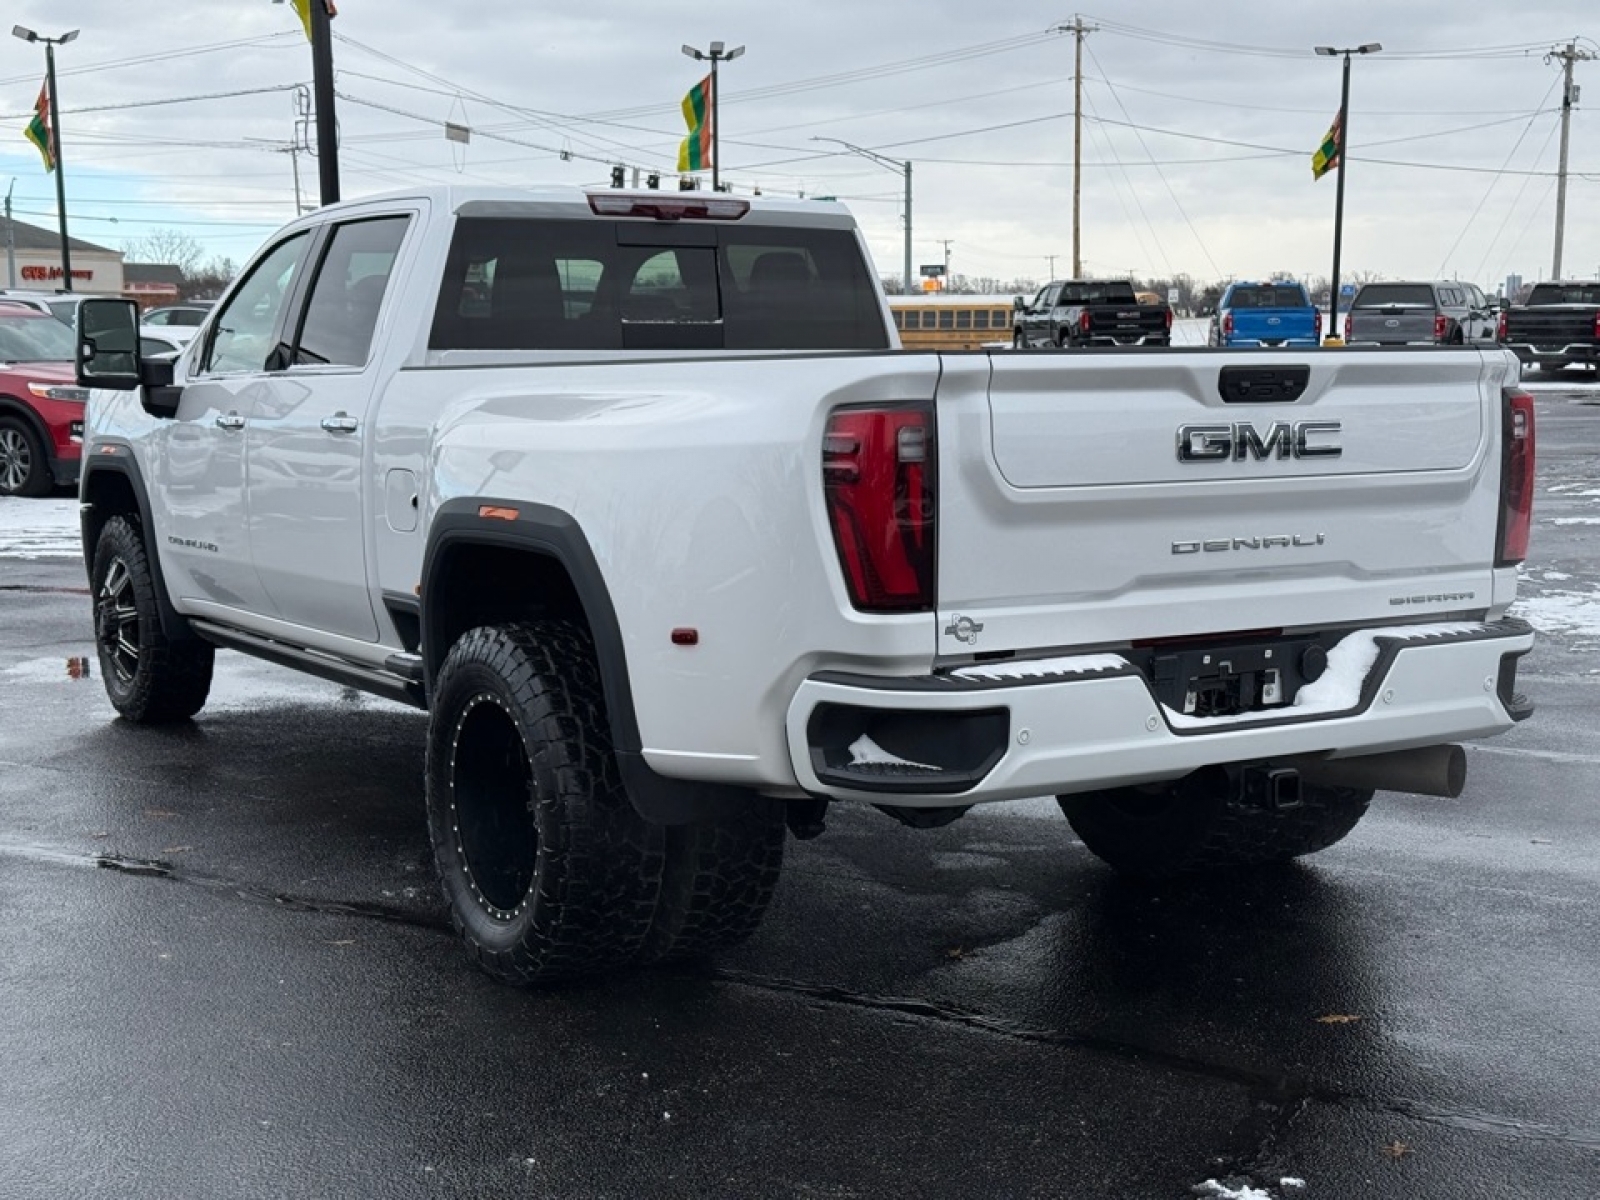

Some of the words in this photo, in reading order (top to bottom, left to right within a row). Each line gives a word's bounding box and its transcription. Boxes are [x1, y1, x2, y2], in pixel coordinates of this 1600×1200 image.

[21, 266, 46, 281] CVS
[1177, 421, 1342, 464] GMC
[1171, 532, 1325, 555] DENALI
[1389, 591, 1475, 605] SIERRA
